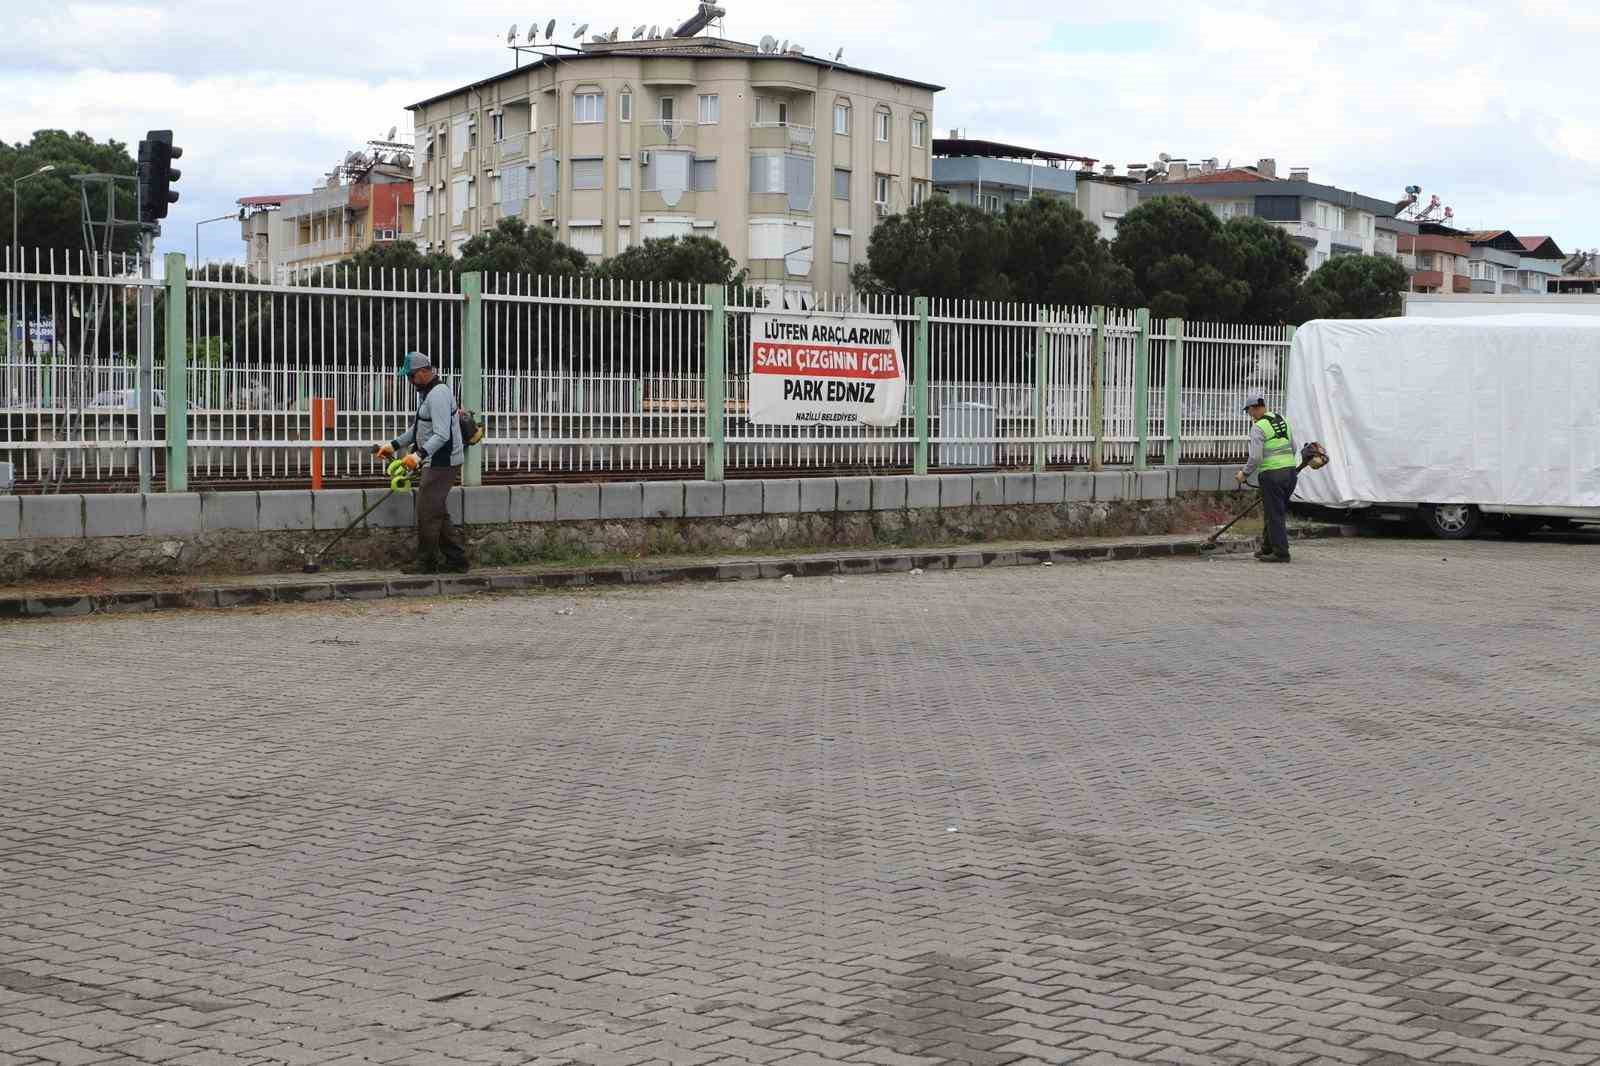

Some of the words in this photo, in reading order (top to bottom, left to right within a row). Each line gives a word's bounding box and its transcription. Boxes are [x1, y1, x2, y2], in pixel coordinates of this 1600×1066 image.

[764, 318, 809, 341] LÜTFEN
[757, 346, 793, 368] SARI
[783, 379, 824, 402] PARK
[795, 410, 821, 421] NAZİLLİ
